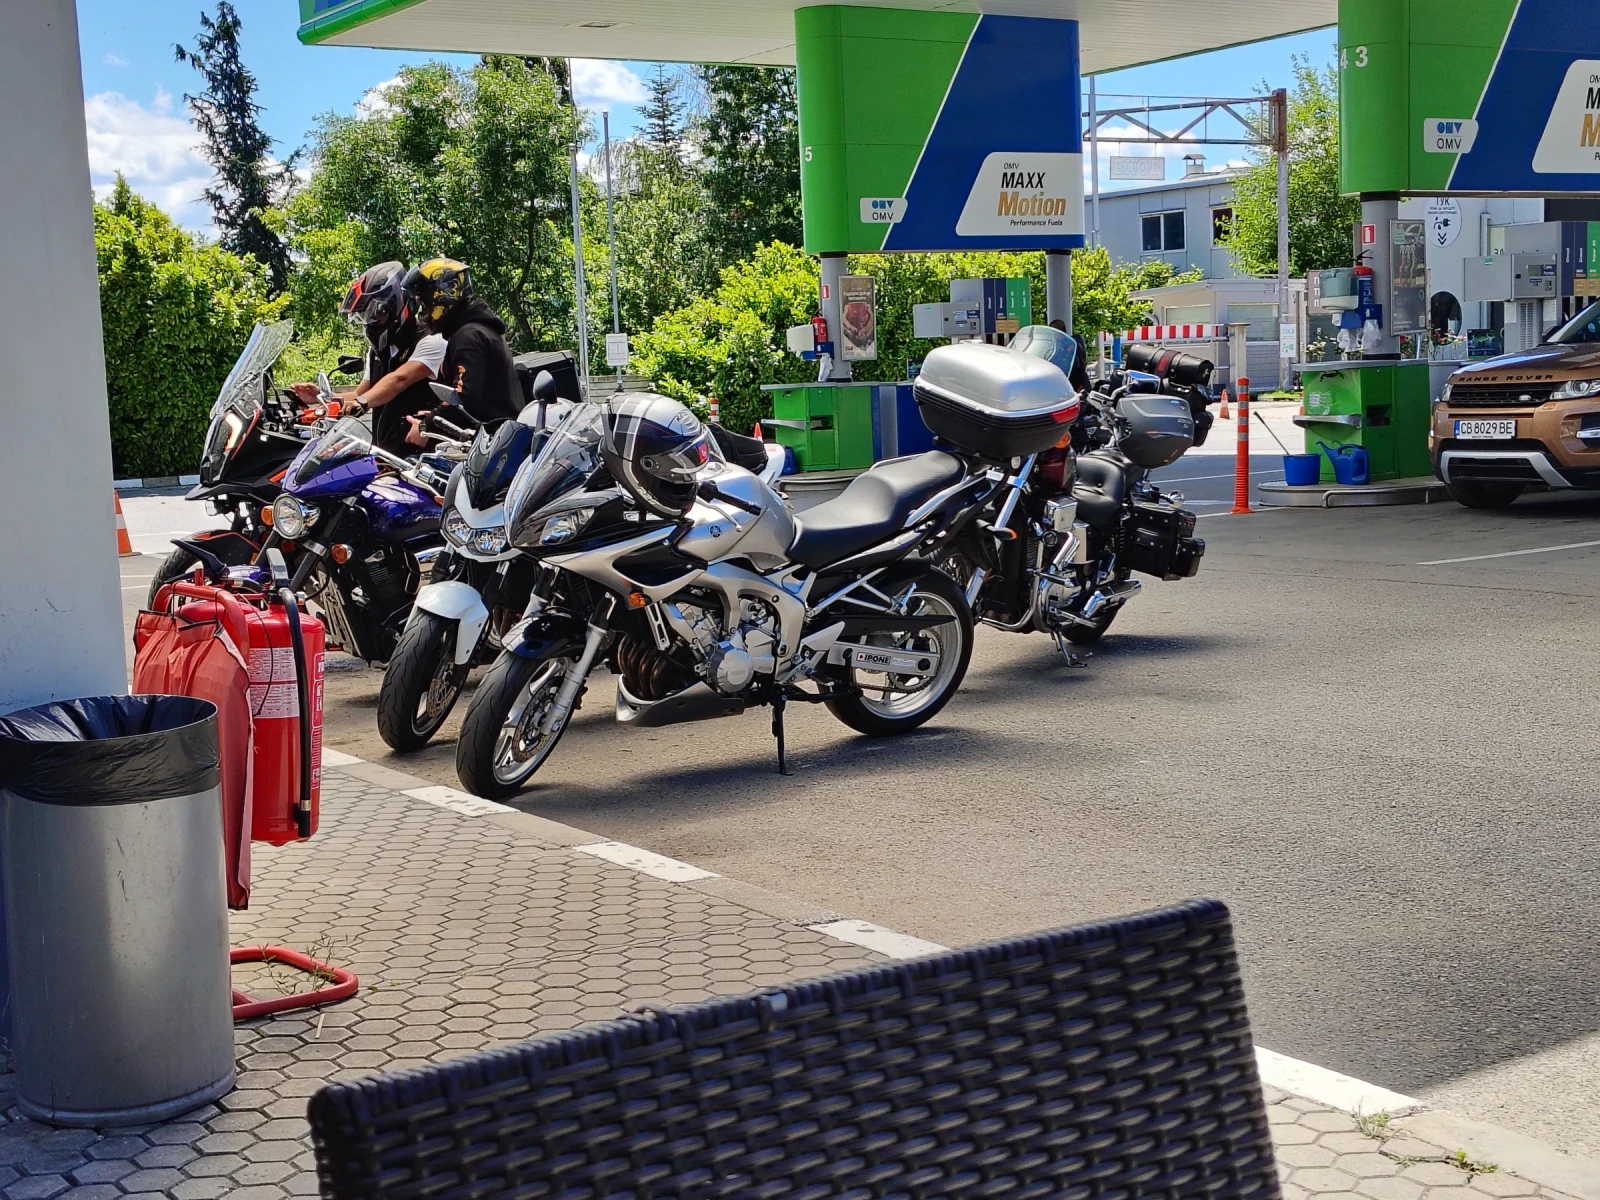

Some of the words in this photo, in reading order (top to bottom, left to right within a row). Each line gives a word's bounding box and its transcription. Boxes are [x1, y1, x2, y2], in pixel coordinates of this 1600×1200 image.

[1340, 48, 1348, 68] 4
[1355, 46, 1368, 68] 3
[1436, 138, 1462, 150] OMV
[804, 146, 812, 162] 5
[1112, 158, 1162, 178] ВХОД
[1001, 172, 1046, 188] MAXX
[998, 192, 1066, 216] Motion
[872, 212, 894, 220] OMV
[1461, 422, 1472, 434] CB
[1474, 422, 1498, 434] 8029
[1499, 422, 1512, 434] BE
[864, 654, 890, 664] IPONE
